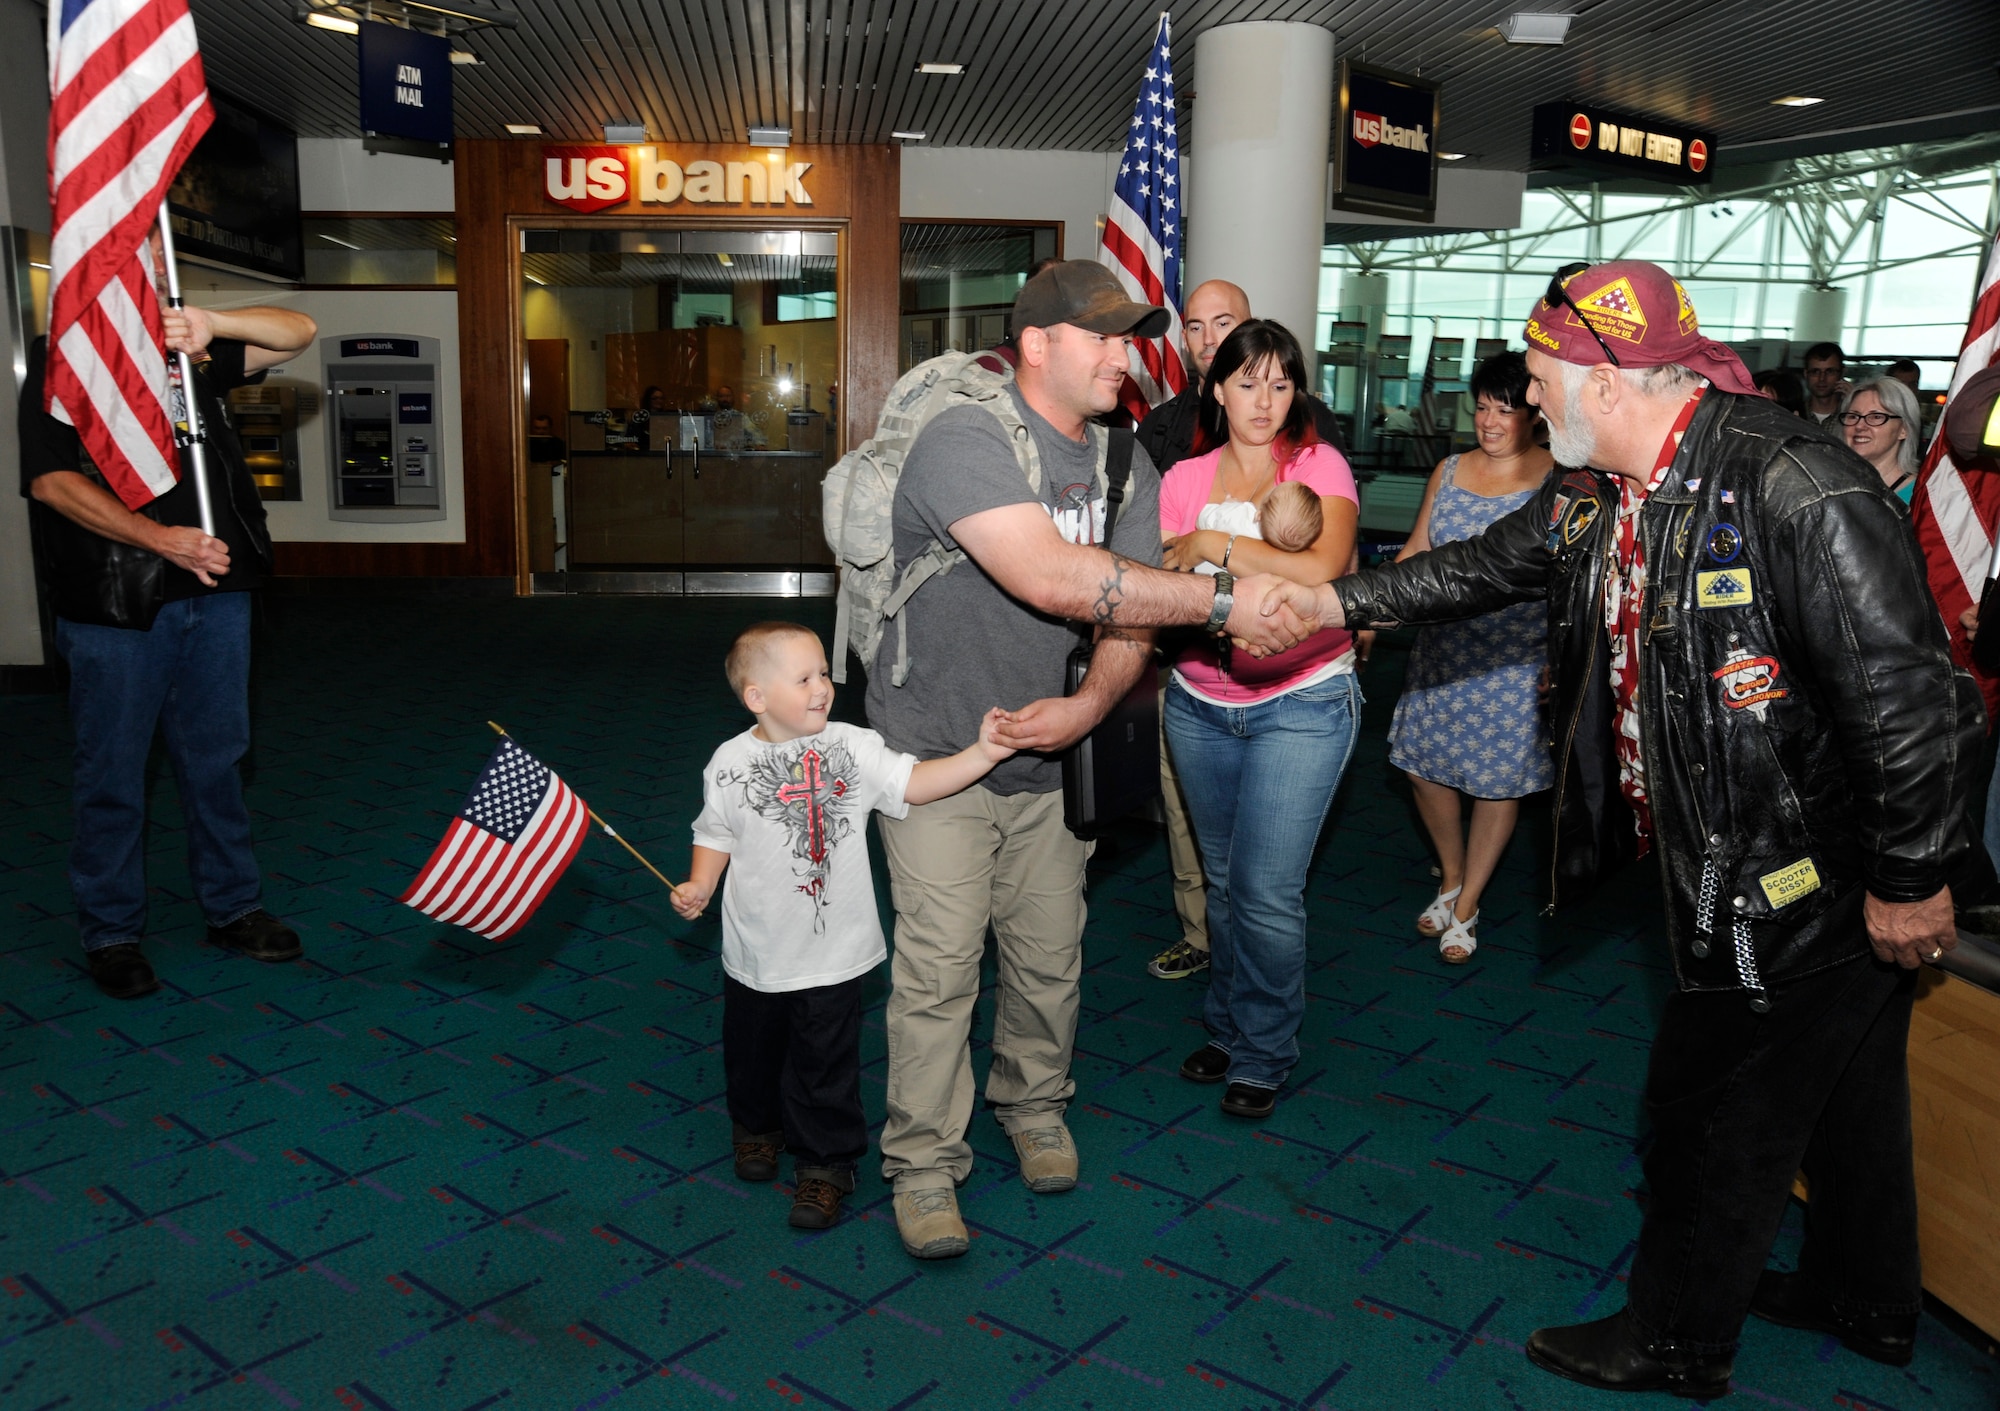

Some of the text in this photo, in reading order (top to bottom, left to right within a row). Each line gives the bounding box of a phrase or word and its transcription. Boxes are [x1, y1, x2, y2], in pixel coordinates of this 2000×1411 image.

[398, 64, 422, 86] ATM
[396, 85, 424, 107] MAIL
[1598, 122, 1682, 166] DO NOT ENTER
[1589, 284, 1636, 312] PATRIOT GUARD
[1596, 306, 1623, 318] RIDERS
[1606, 316, 1617, 326] for
[1617, 319, 1637, 333] Those
[1610, 326, 1622, 336] for
[1621, 329, 1633, 339] US
[1527, 320, 1560, 350] Riders
[1703, 572, 1721, 594] PATRIOT
[1722, 660, 1754, 674] DEATH
[1735, 678, 1767, 693] BEFORE
[1738, 691, 1783, 707] DISHONOR
[1766, 865, 1812, 890] SCOOTER
[1779, 877, 1806, 894] SISSY
